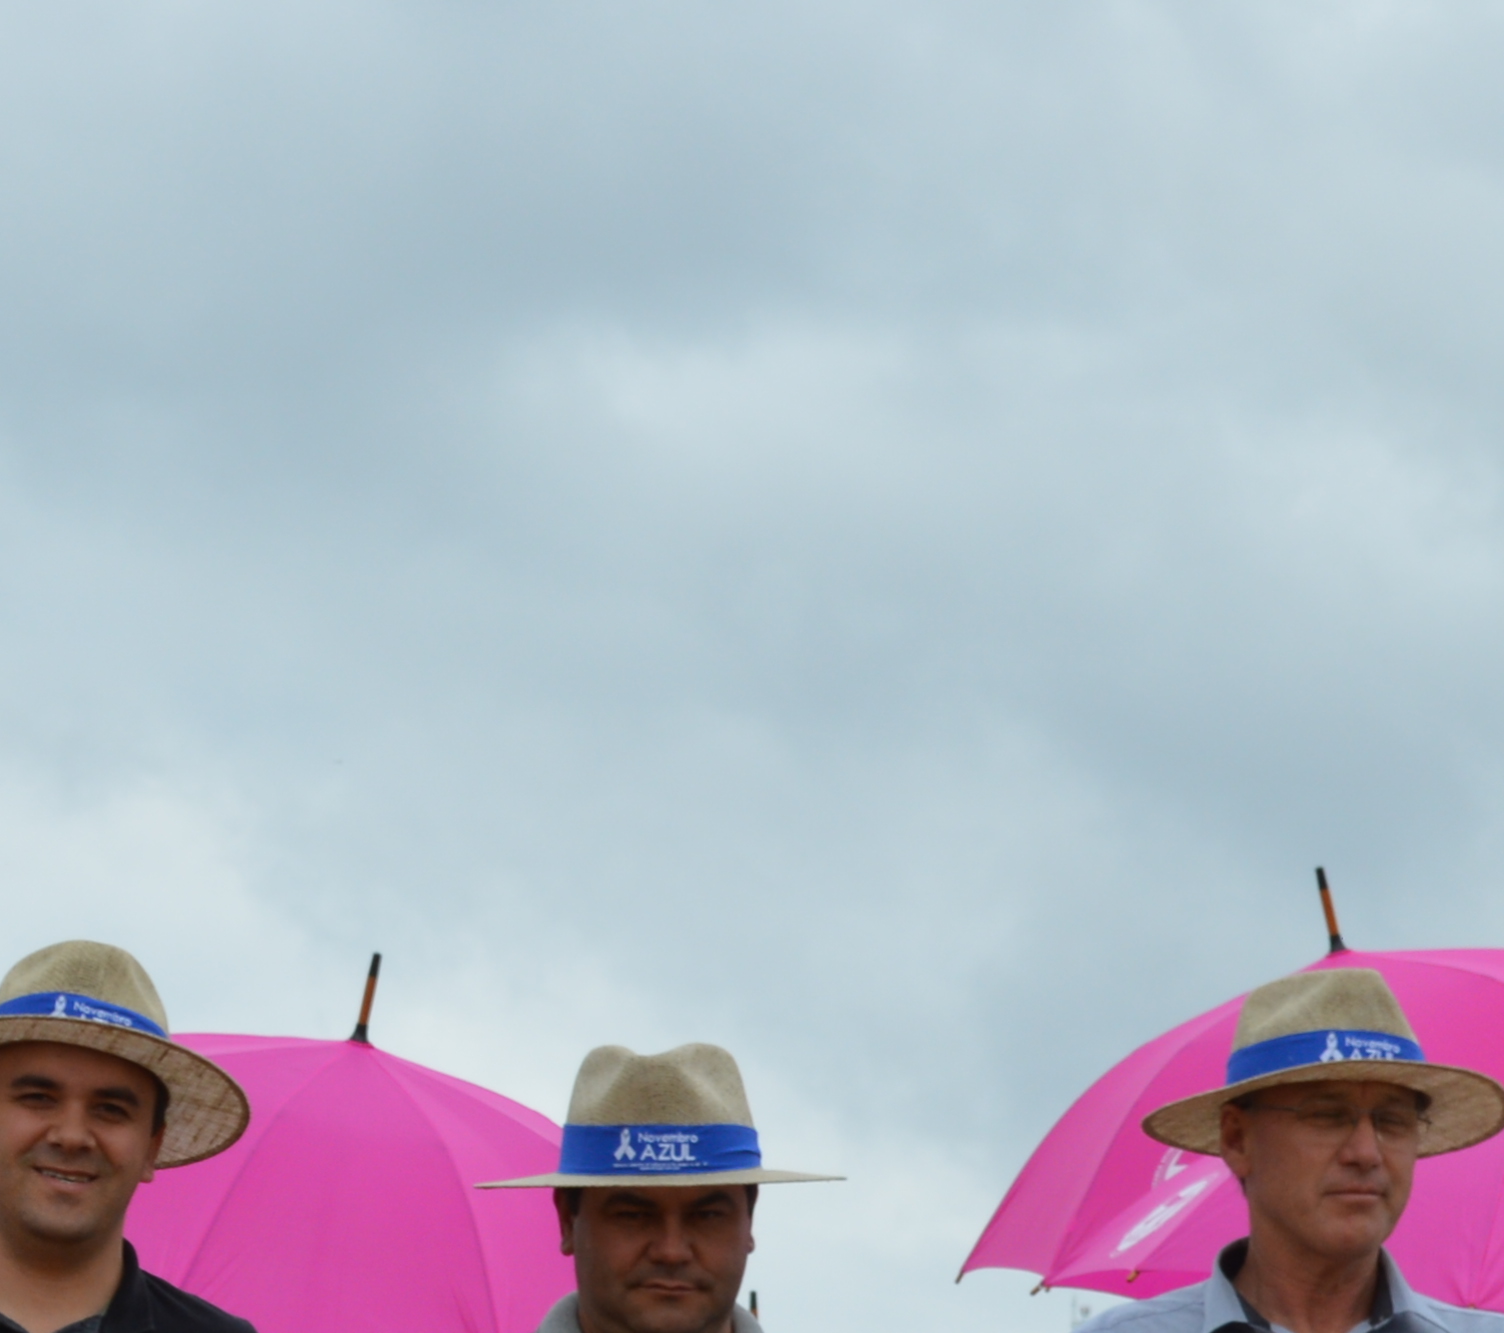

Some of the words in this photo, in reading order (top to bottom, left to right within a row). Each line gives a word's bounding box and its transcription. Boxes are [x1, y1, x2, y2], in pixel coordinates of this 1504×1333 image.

[1345, 1036, 1401, 1054] Novembro
[637, 1132, 699, 1143] Novembro
[640, 1143, 697, 1162] AZUL
